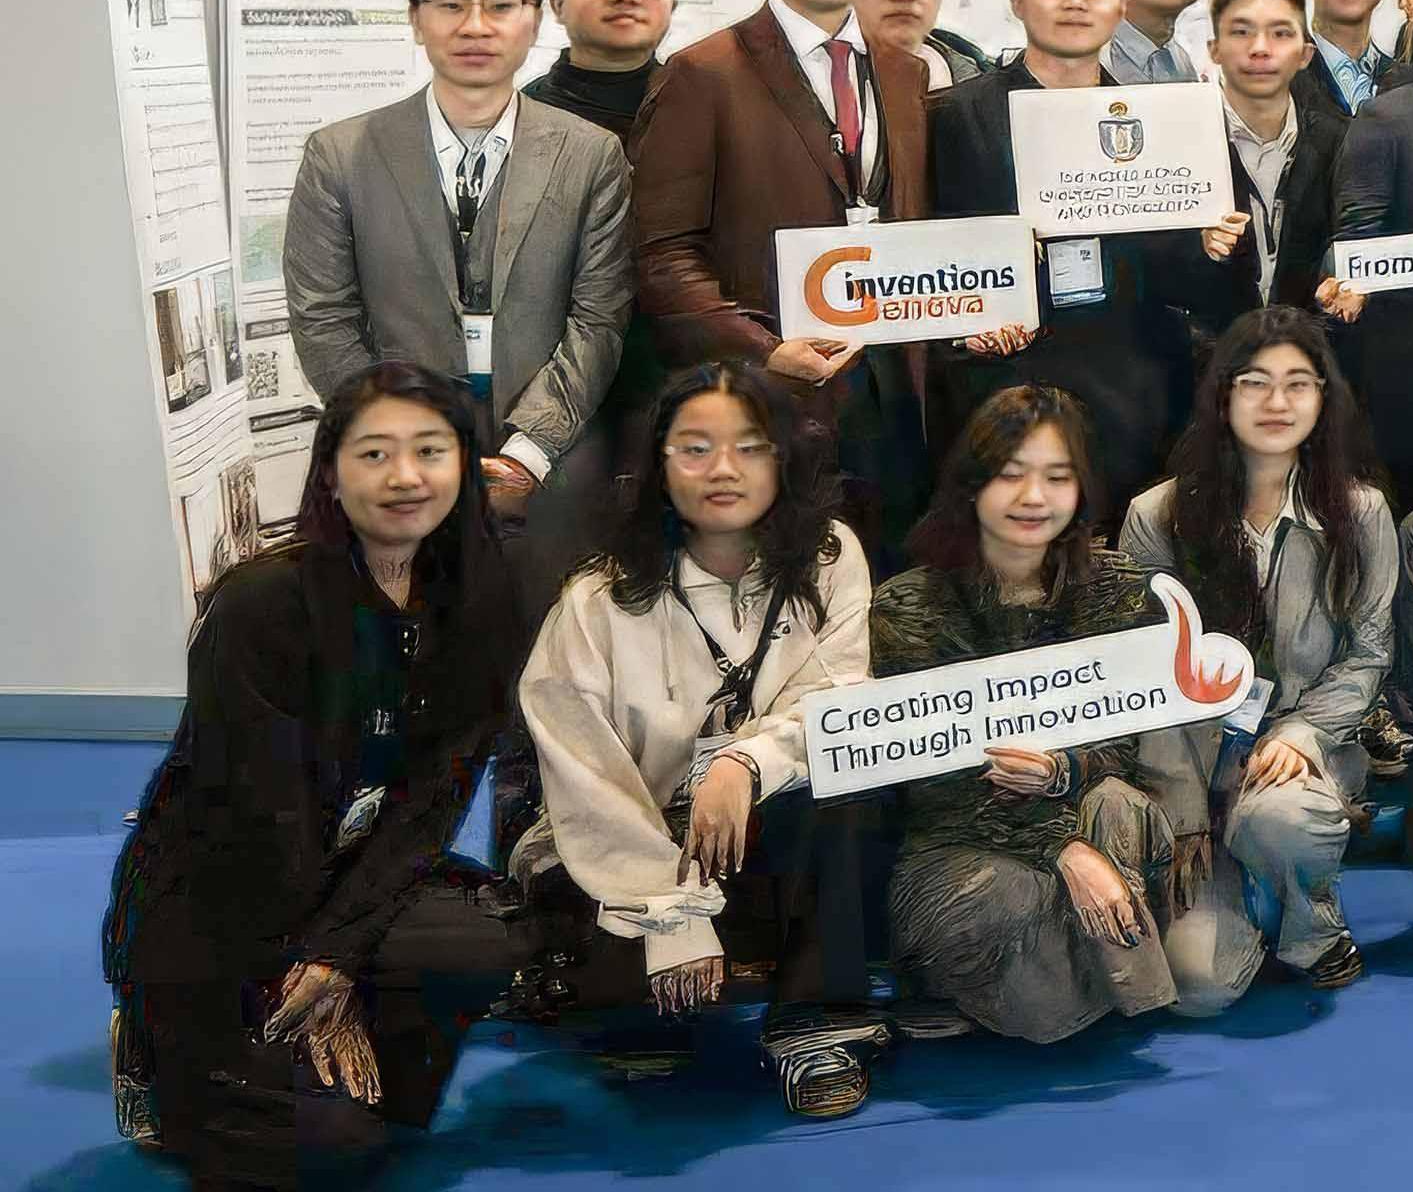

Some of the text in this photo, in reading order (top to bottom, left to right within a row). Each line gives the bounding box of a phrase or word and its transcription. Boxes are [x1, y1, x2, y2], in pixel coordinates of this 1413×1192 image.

[845, 264, 1016, 301] inventions
[1349, 255, 1413, 279] From
[820, 660, 1107, 735] Creating Impact
[822, 688, 1167, 773] Through Innovation
